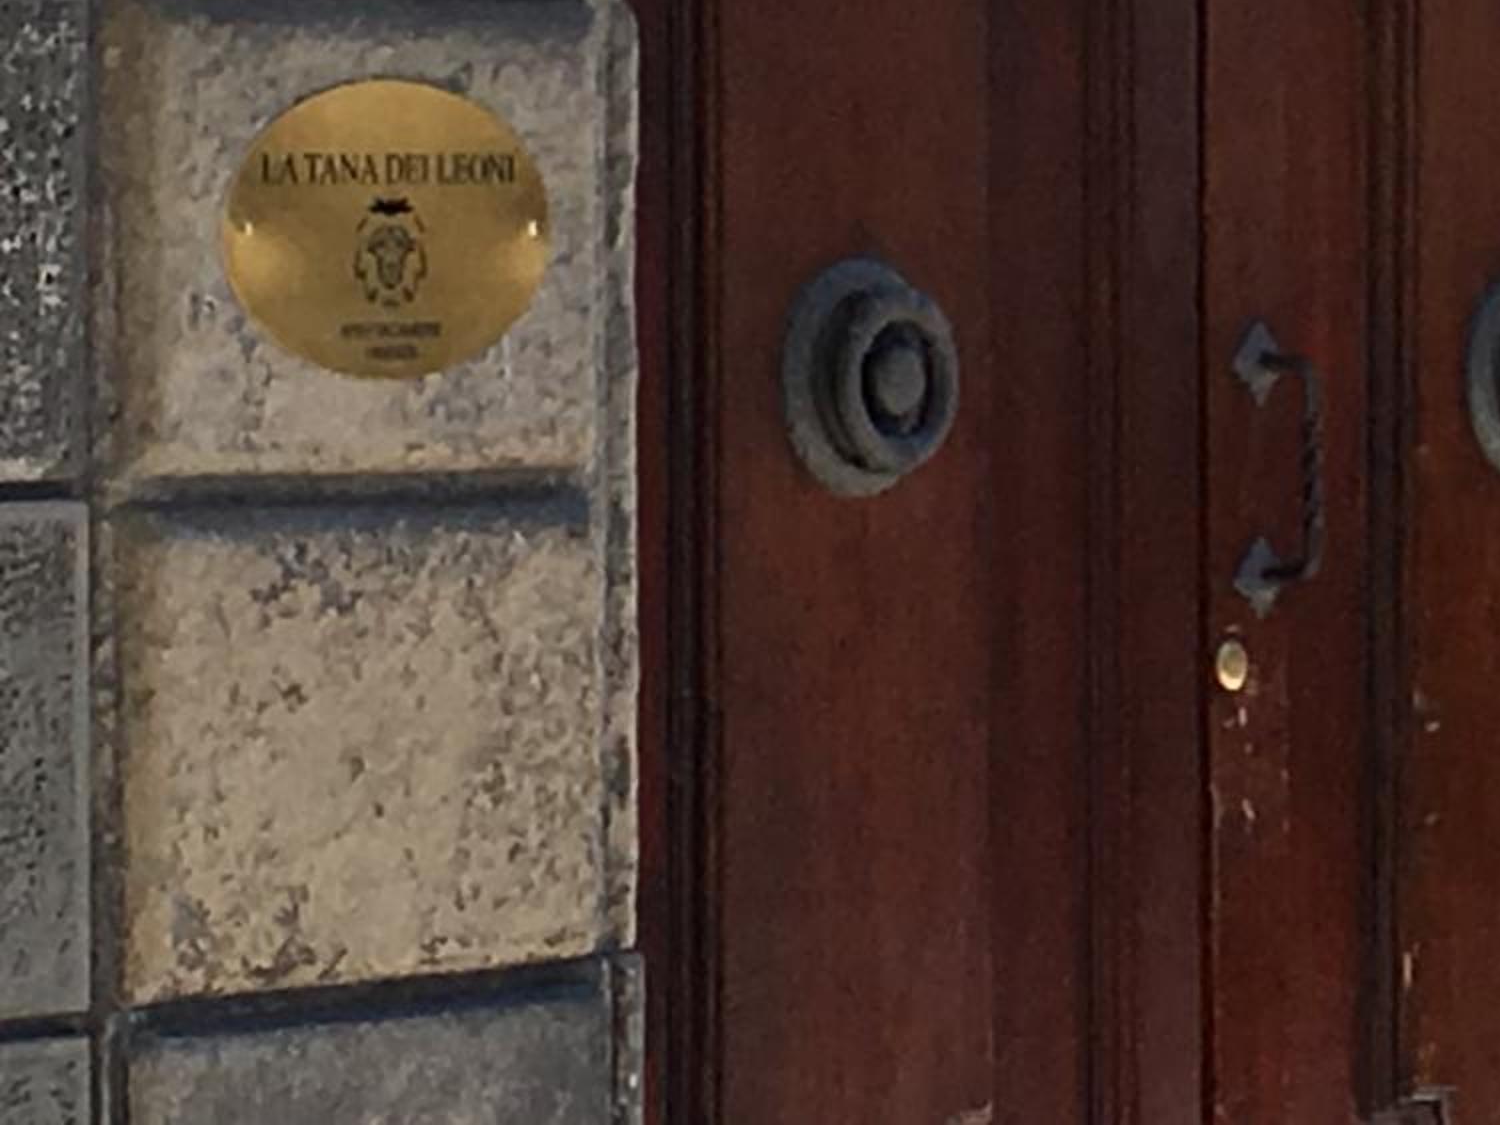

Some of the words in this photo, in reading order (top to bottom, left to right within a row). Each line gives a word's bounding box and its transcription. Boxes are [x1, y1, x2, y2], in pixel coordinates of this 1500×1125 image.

[261, 153, 298, 184] LA
[303, 153, 378, 184] TANA
[385, 153, 429, 184] DEI
[437, 153, 515, 184] LEONI
